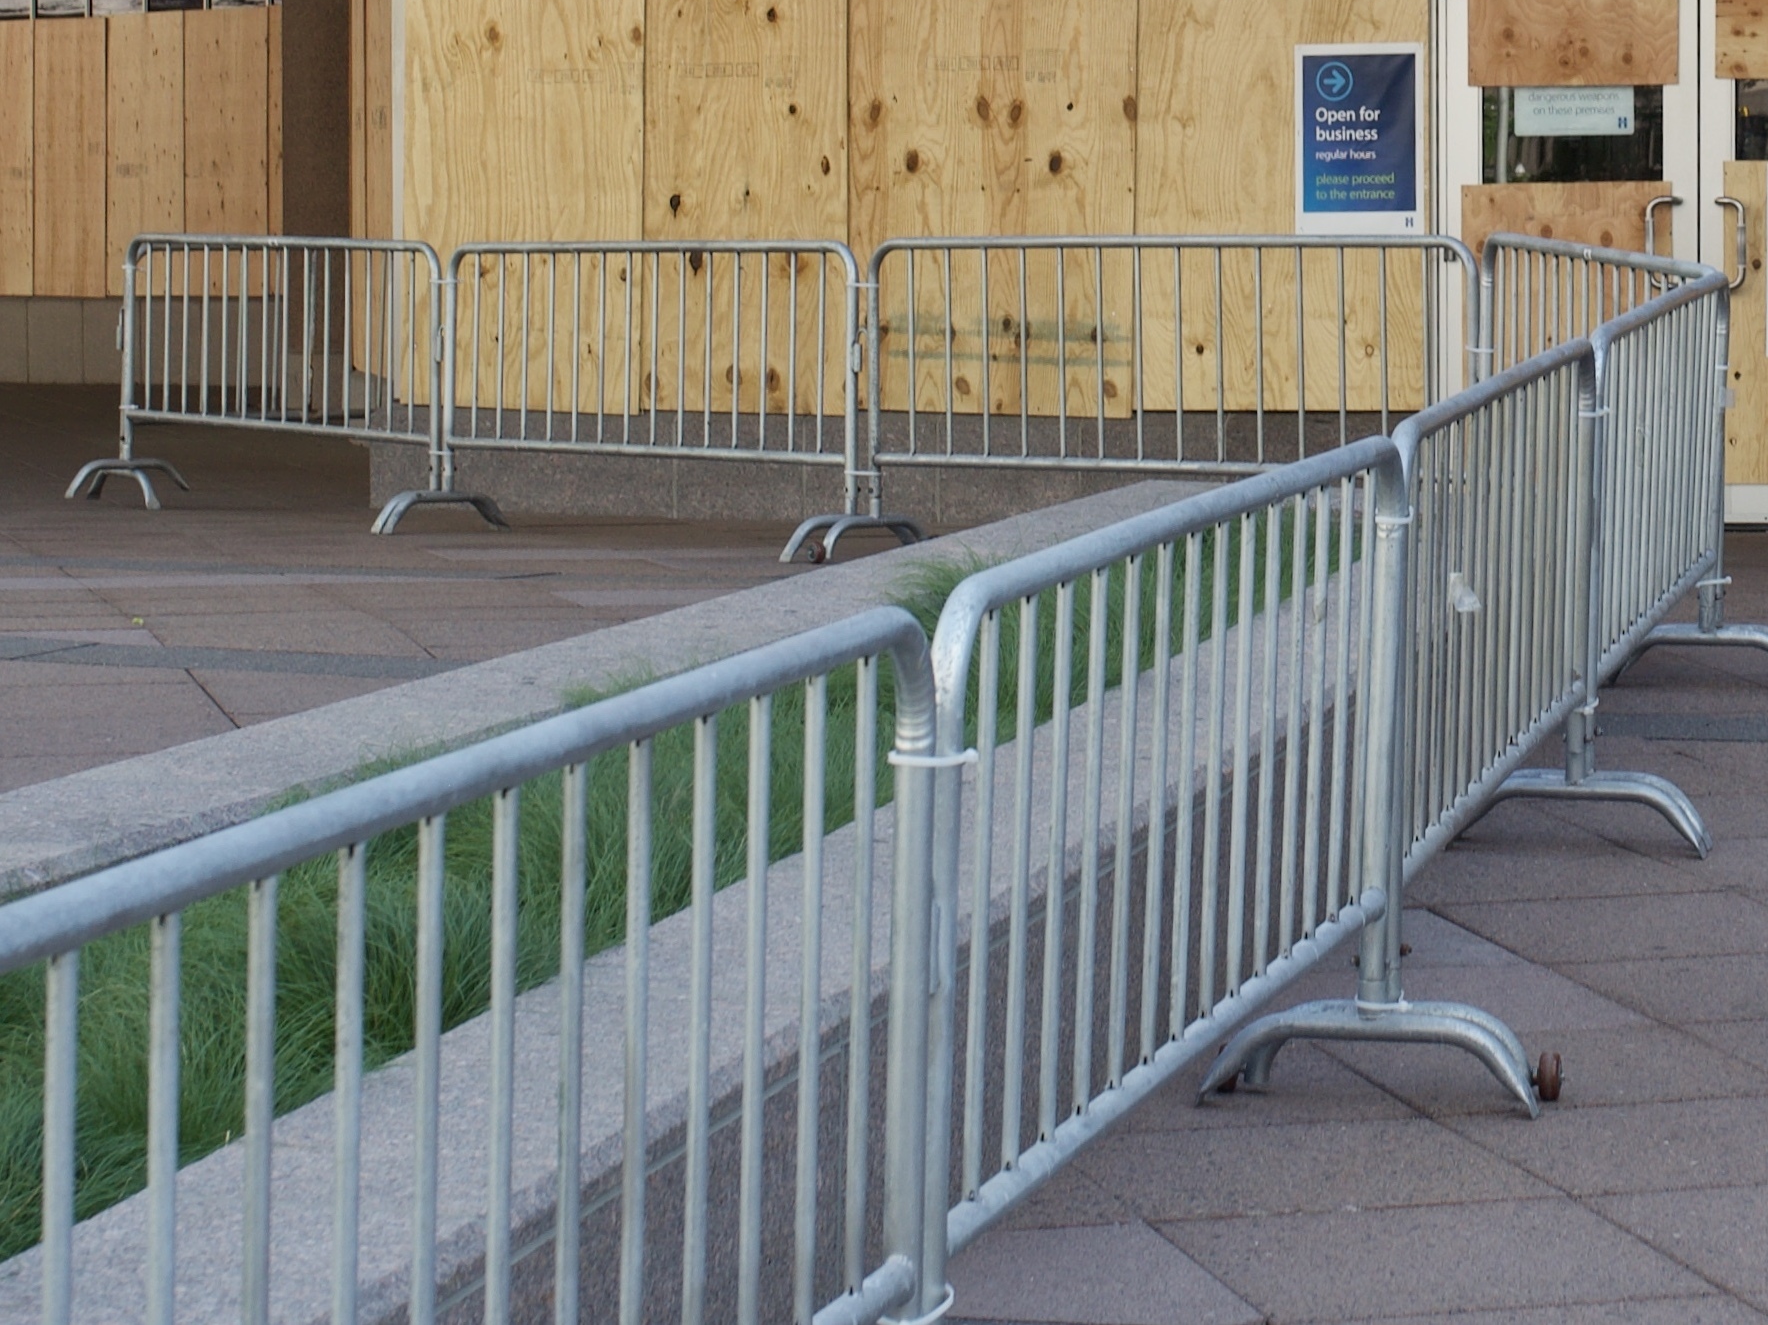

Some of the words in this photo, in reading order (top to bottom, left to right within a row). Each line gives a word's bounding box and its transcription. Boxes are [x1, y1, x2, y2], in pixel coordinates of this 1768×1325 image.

[1528, 92, 1576, 103] dangerous
[1578, 92, 1620, 102] weapons
[1315, 107, 1356, 125] Open
[1359, 106, 1380, 122] for
[1548, 106, 1573, 115] these
[1575, 106, 1615, 116] premises
[1315, 126, 1379, 141] business
[1315, 150, 1348, 162] regular
[1349, 149, 1377, 160] hours
[1315, 173, 1349, 186] please
[1351, 172, 1395, 186] proceed
[1316, 189, 1328, 199] to
[1329, 188, 1347, 199] the
[1349, 190, 1396, 200] entrance
